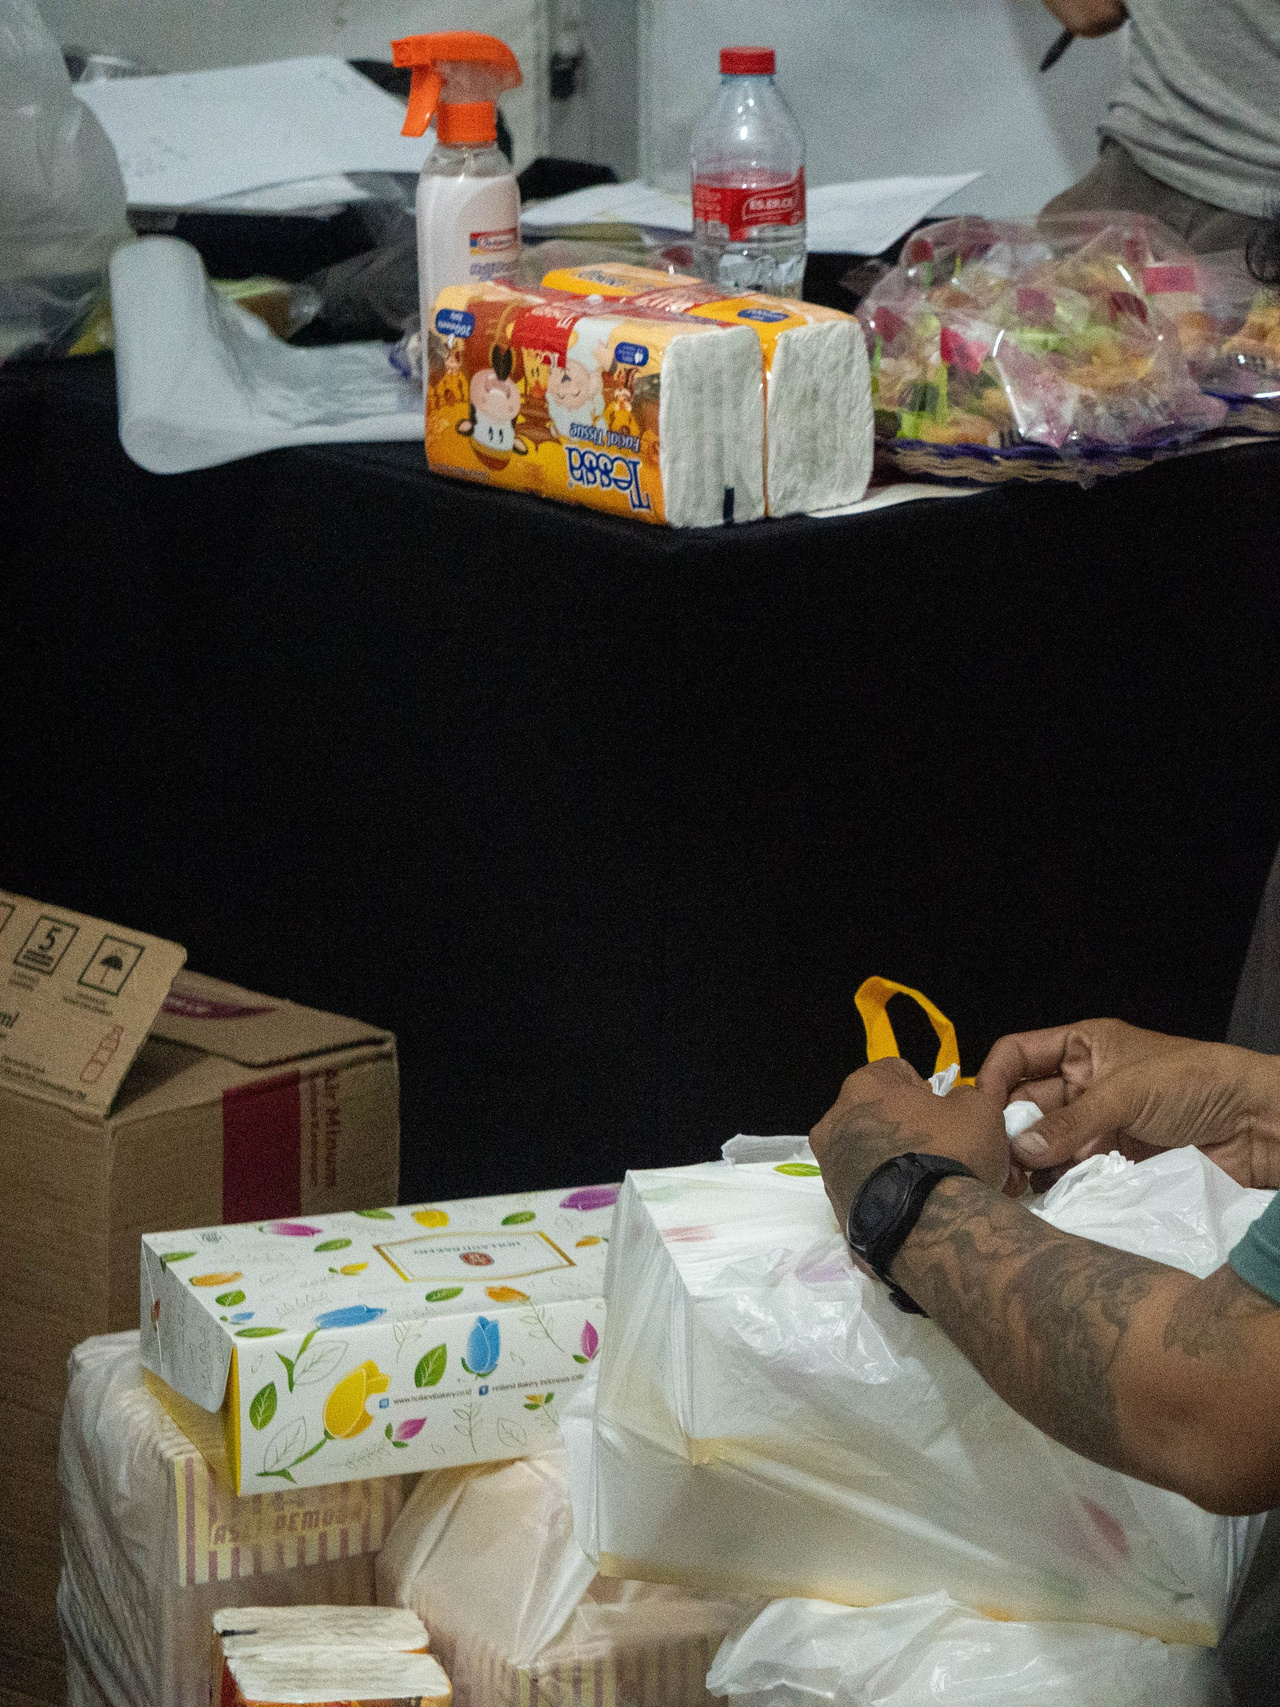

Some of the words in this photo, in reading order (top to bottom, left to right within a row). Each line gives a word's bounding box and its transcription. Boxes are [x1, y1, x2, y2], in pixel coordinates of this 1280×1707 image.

[569, 422, 604, 447] Tissue
[606, 431, 641, 453] Facial
[566, 446, 652, 511] Tessa
[38, 926, 62, 951] 5
